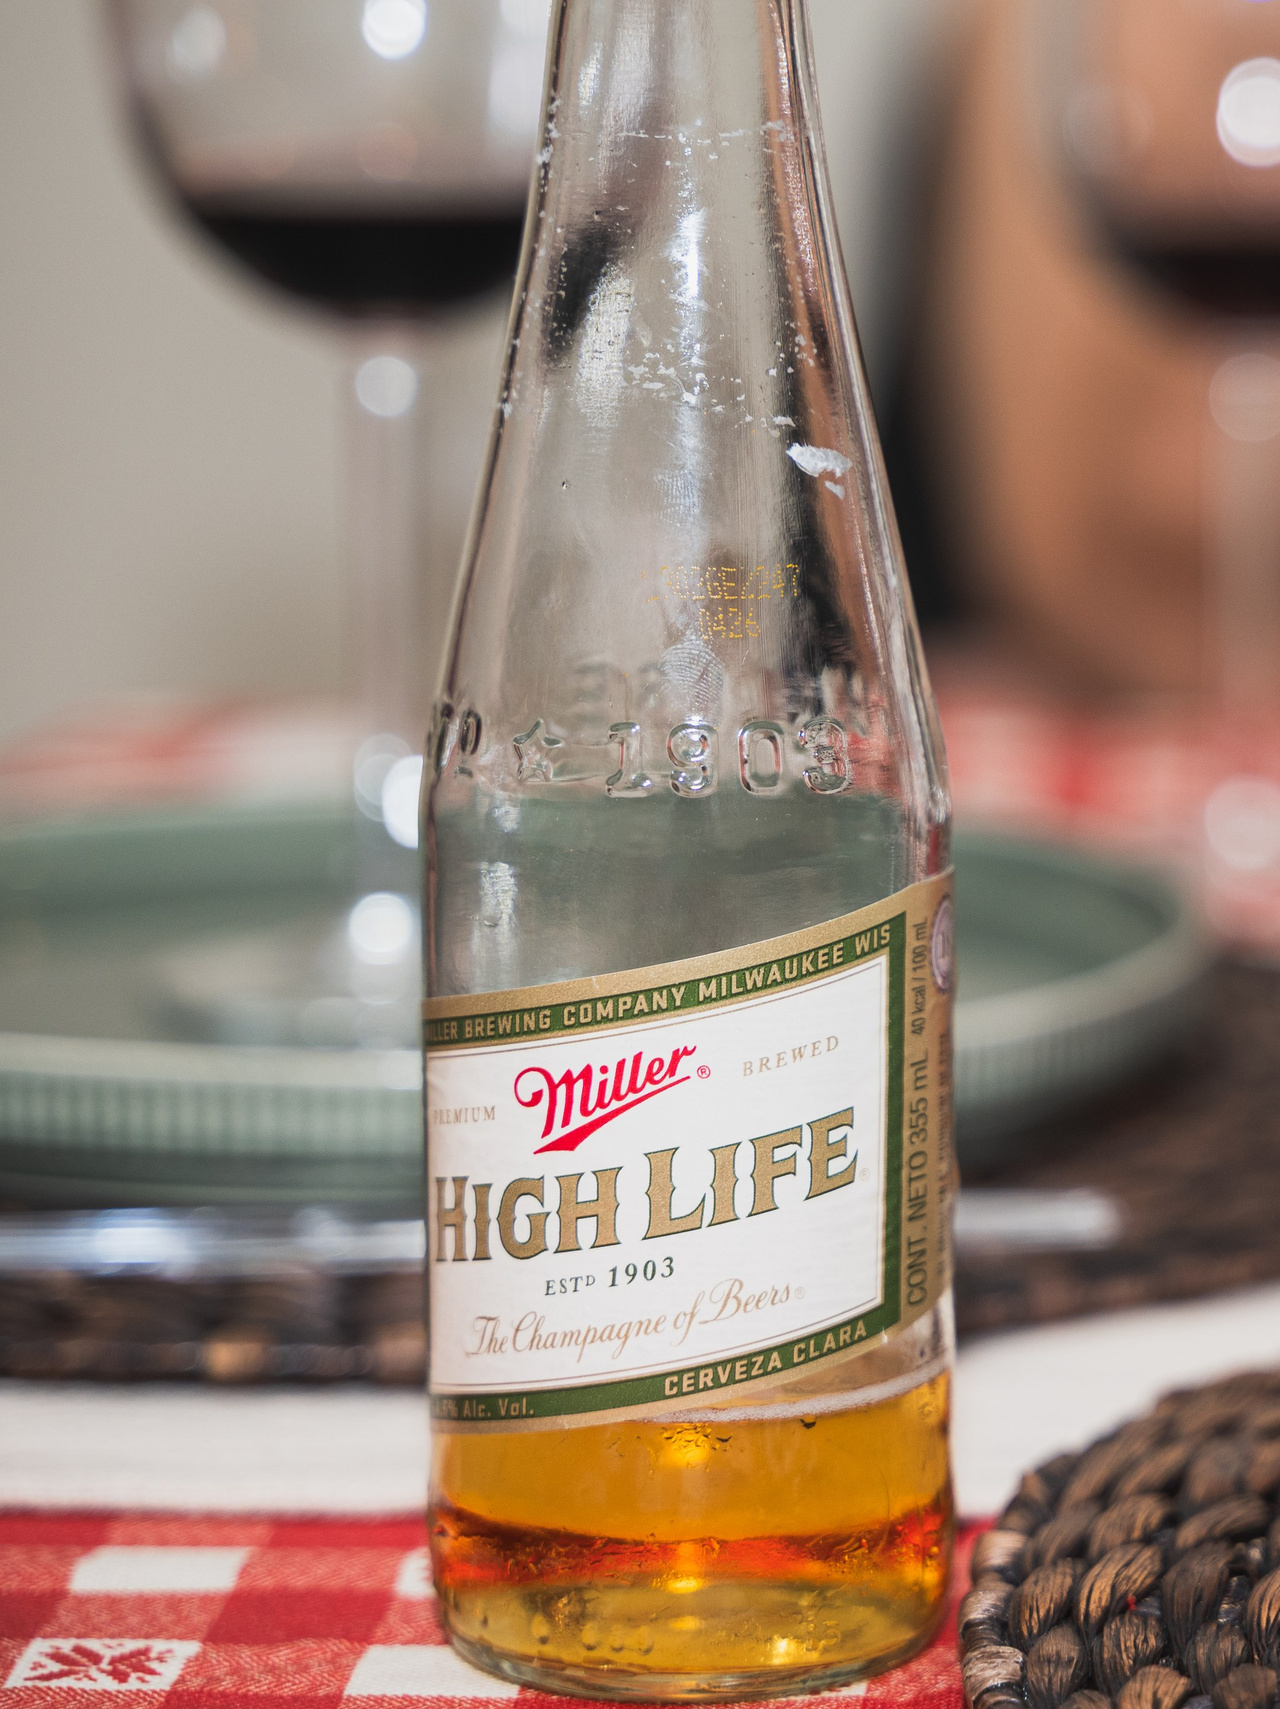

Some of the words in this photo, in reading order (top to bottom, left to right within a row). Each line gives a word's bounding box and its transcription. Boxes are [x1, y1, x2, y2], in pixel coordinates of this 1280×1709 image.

[604, 715, 851, 798] 1903
[912, 916, 928, 942] mL
[912, 943, 927, 972] 100
[464, 1009, 552, 1039] BREWING
[562, 986, 685, 1025] COMPANY
[698, 942, 845, 1002] MILWAUKEE
[855, 922, 892, 956] WIS
[911, 984, 926, 1015] kcal
[911, 1017, 926, 1035] 40
[742, 1035, 840, 1079] BREWED
[910, 1048, 929, 1091] mL
[432, 1104, 497, 1125] PREMIUM
[909, 1097, 928, 1146] 355
[434, 1166, 624, 1262] HIGH
[641, 1106, 858, 1242] LIFE
[907, 1150, 928, 1223] NETO
[607, 1256, 676, 1289] 1903
[467, 1315, 509, 1357] The
[512, 1310, 665, 1364] Champagne
[670, 1291, 707, 1347] of
[698, 1277, 792, 1326] Beers
[664, 1351, 783, 1397] CERVEZA
[793, 1319, 868, 1365] CLARA
[463, 1399, 492, 1419] Alc.
[497, 1396, 535, 1417] Vol.
